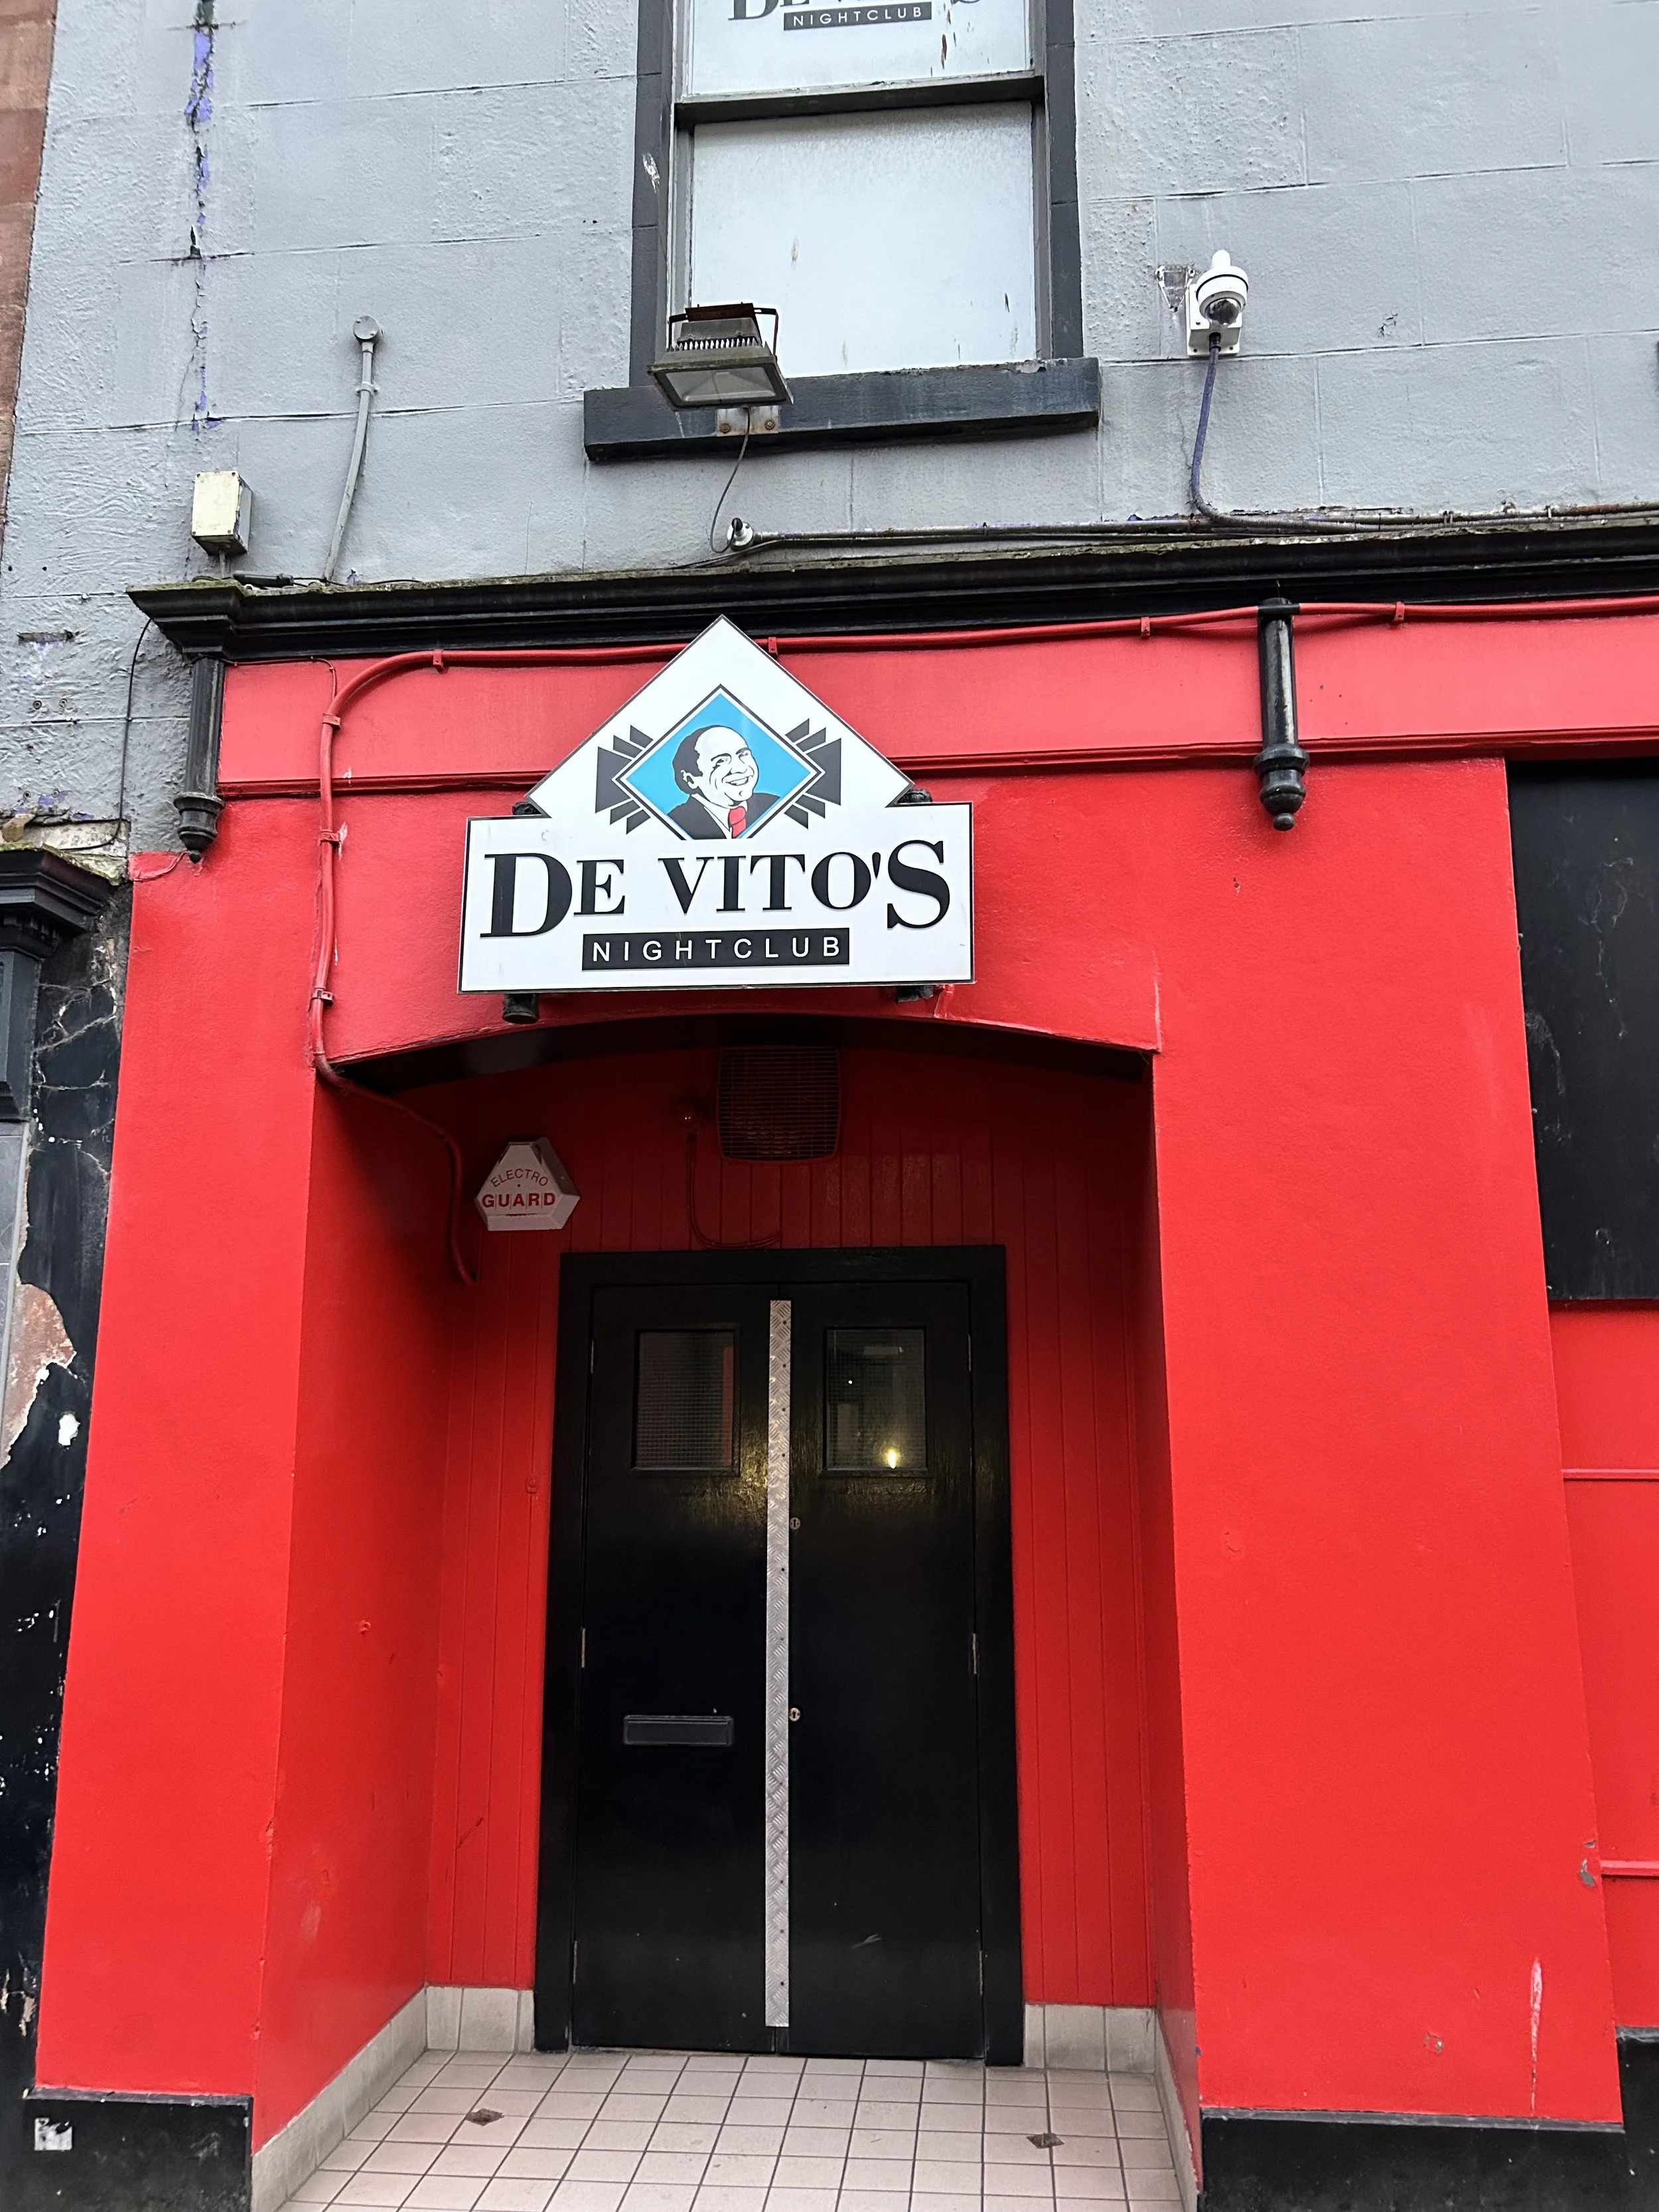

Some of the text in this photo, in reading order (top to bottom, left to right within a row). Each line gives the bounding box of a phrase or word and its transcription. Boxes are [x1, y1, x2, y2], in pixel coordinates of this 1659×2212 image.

[793, 7, 922, 27] NIGHTCLUB
[479, 840, 950, 938] DE VITO'S
[593, 936, 840, 962] NIGHTCLUB
[490, 1168, 549, 1187] ELECTRO
[482, 1193, 555, 1207] GUARD
